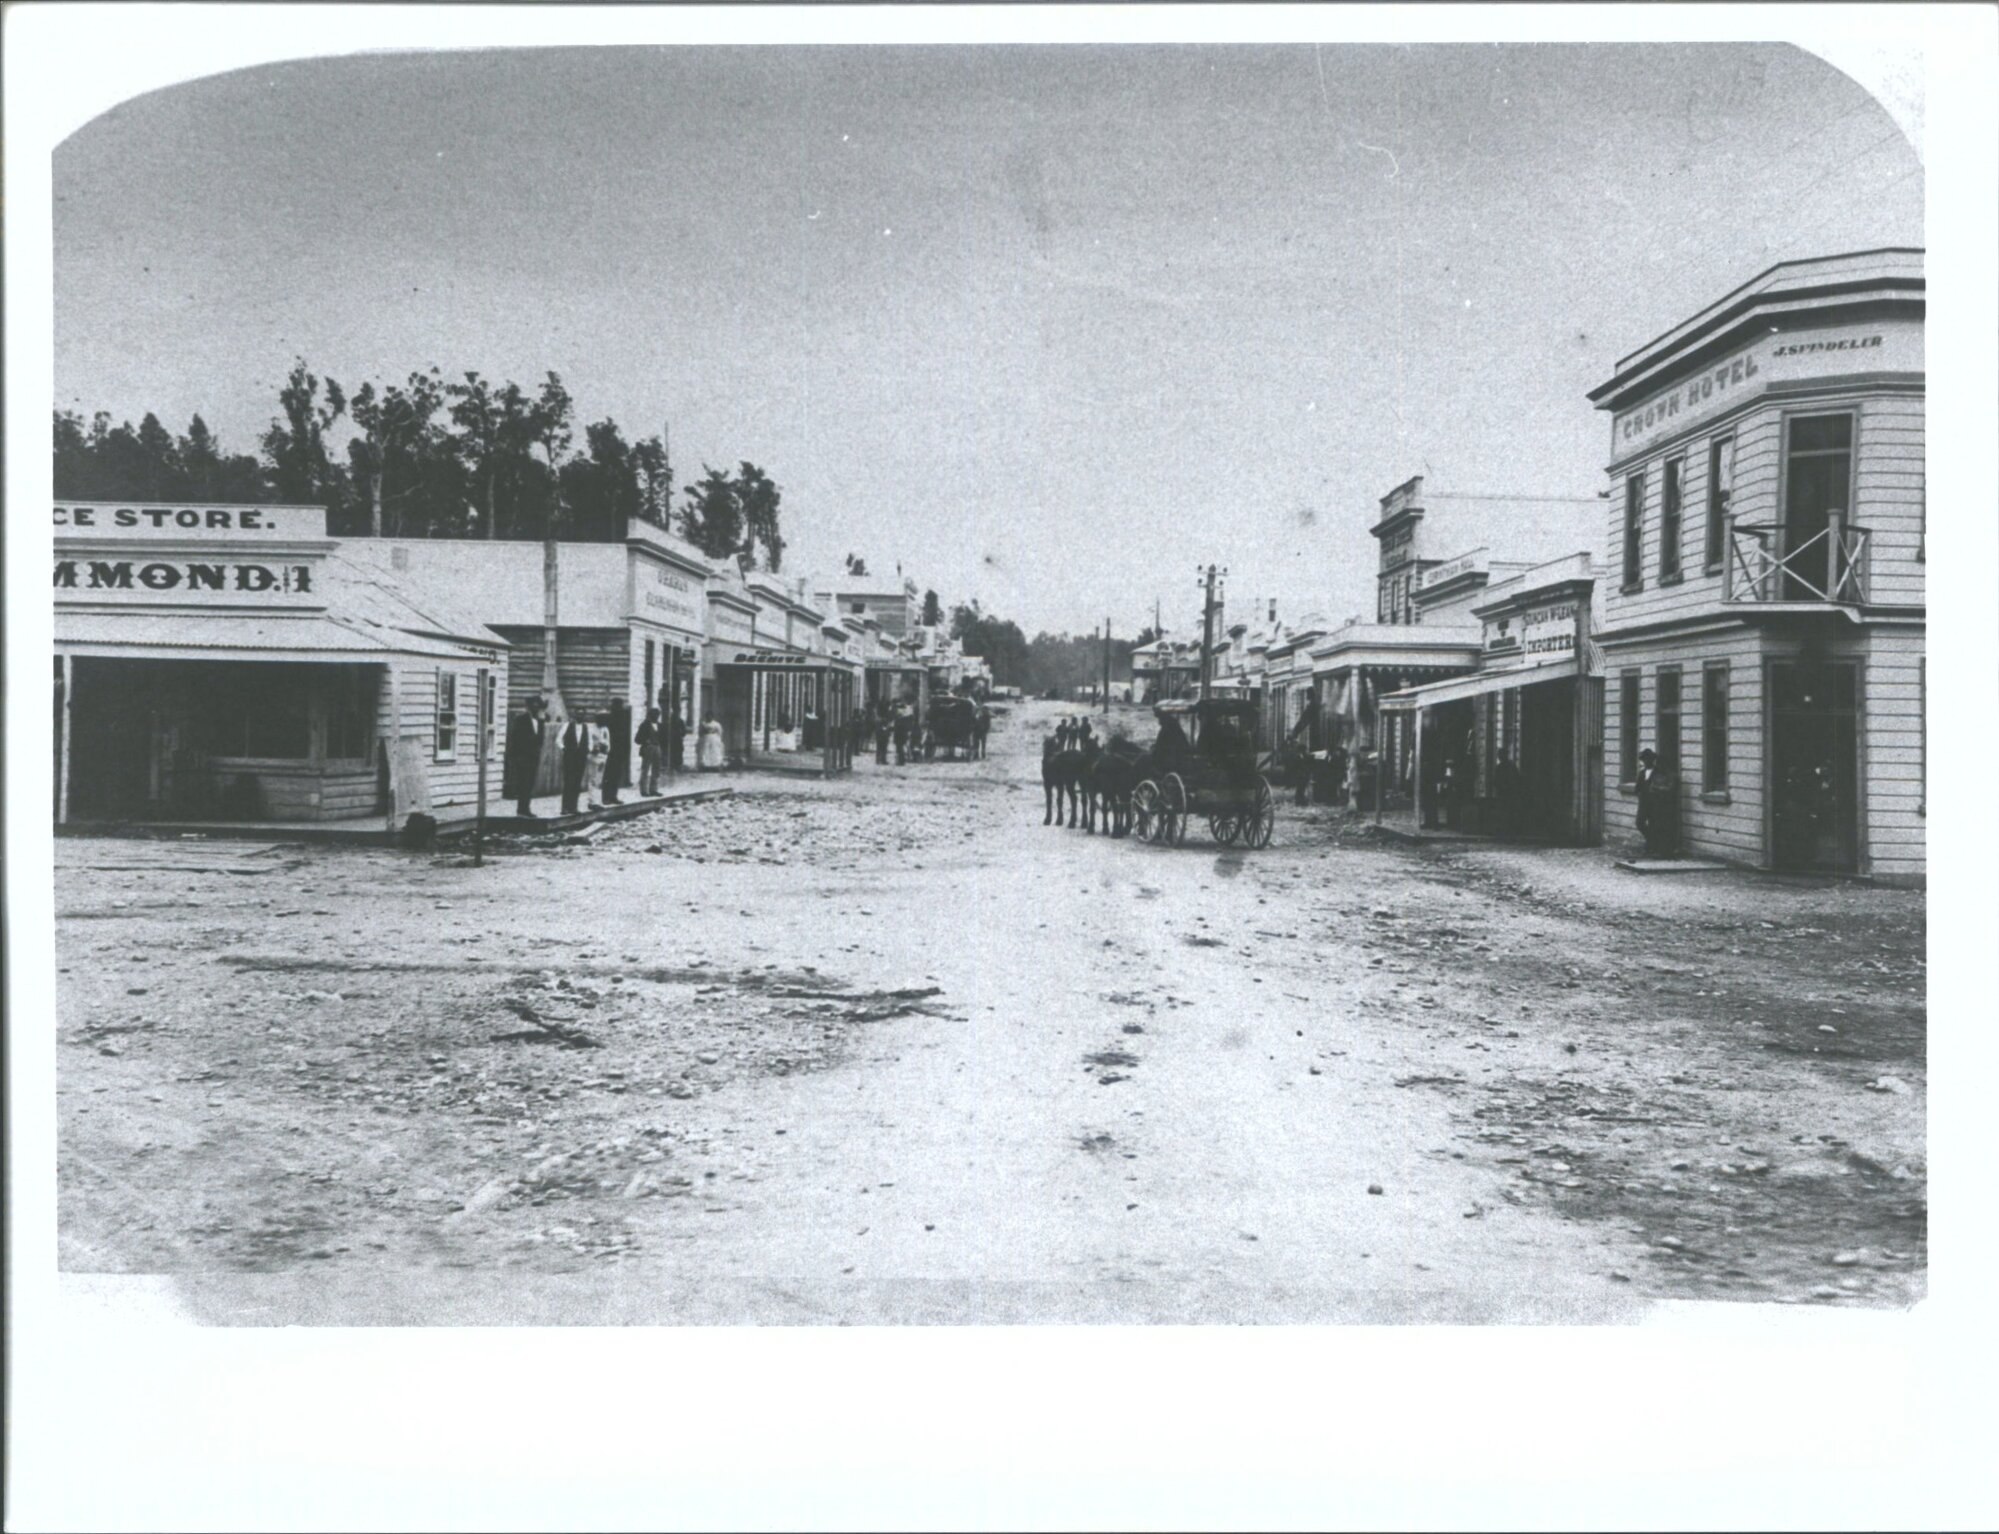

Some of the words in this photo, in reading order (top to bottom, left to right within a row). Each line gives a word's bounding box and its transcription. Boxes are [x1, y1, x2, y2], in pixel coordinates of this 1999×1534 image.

[1623, 393, 1680, 439] CROWN
[1687, 354, 1759, 407] HOTEL
[114, 508, 276, 529] STORE.
[734, 653, 807, 664] BEEHIVE
